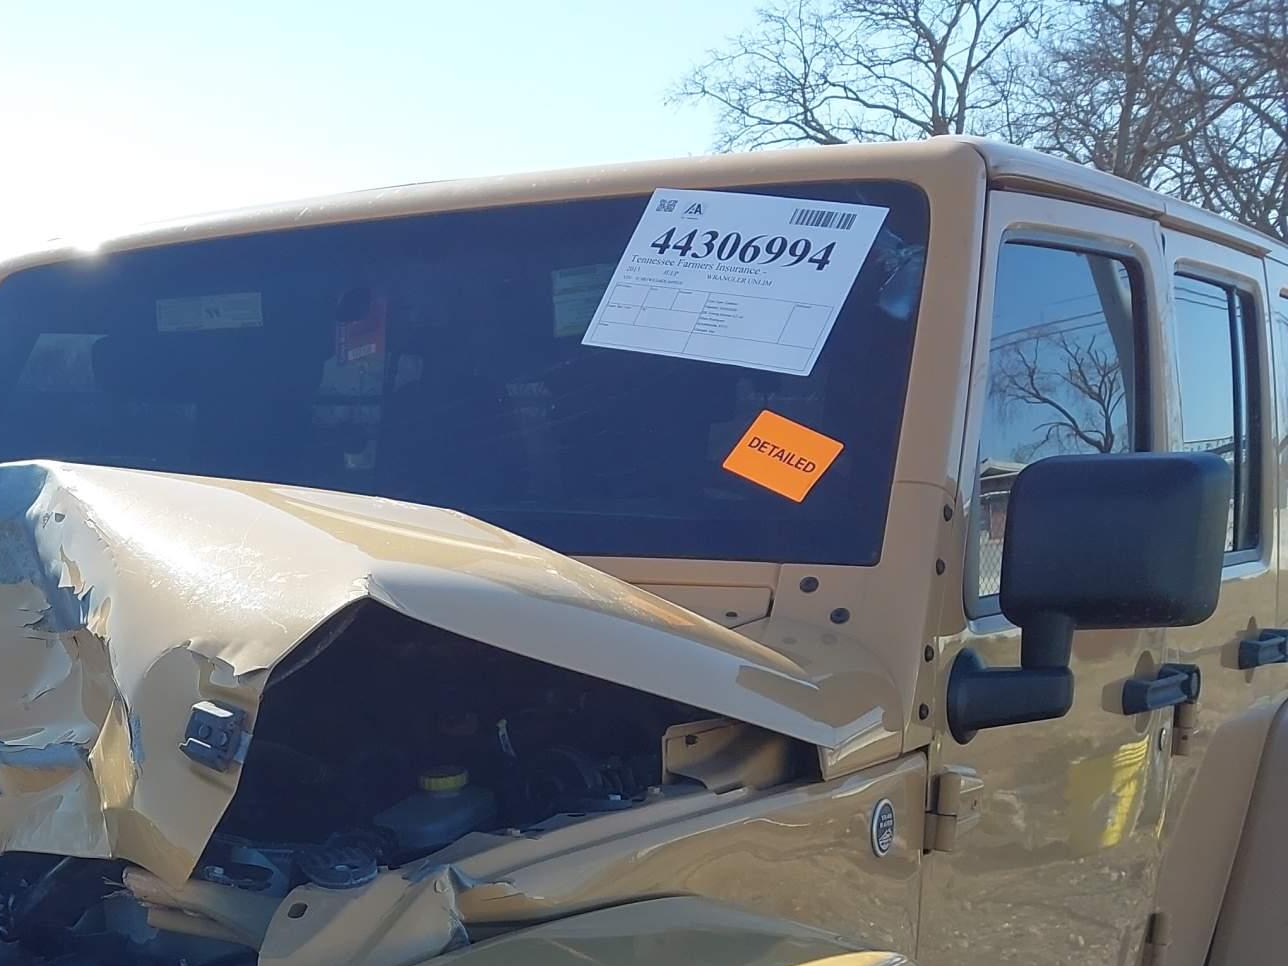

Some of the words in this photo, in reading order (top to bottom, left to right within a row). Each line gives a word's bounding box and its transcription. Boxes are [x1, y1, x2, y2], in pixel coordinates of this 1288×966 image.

[650, 226, 837, 271] 44306994
[631, 254, 675, 267] Tennessee
[677, 258, 714, 270] Farmers
[715, 262, 761, 275] Insurance
[706, 273, 746, 284] WRANGLER
[746, 277, 773, 287] UNLIM
[748, 436, 816, 474] DETAILED
